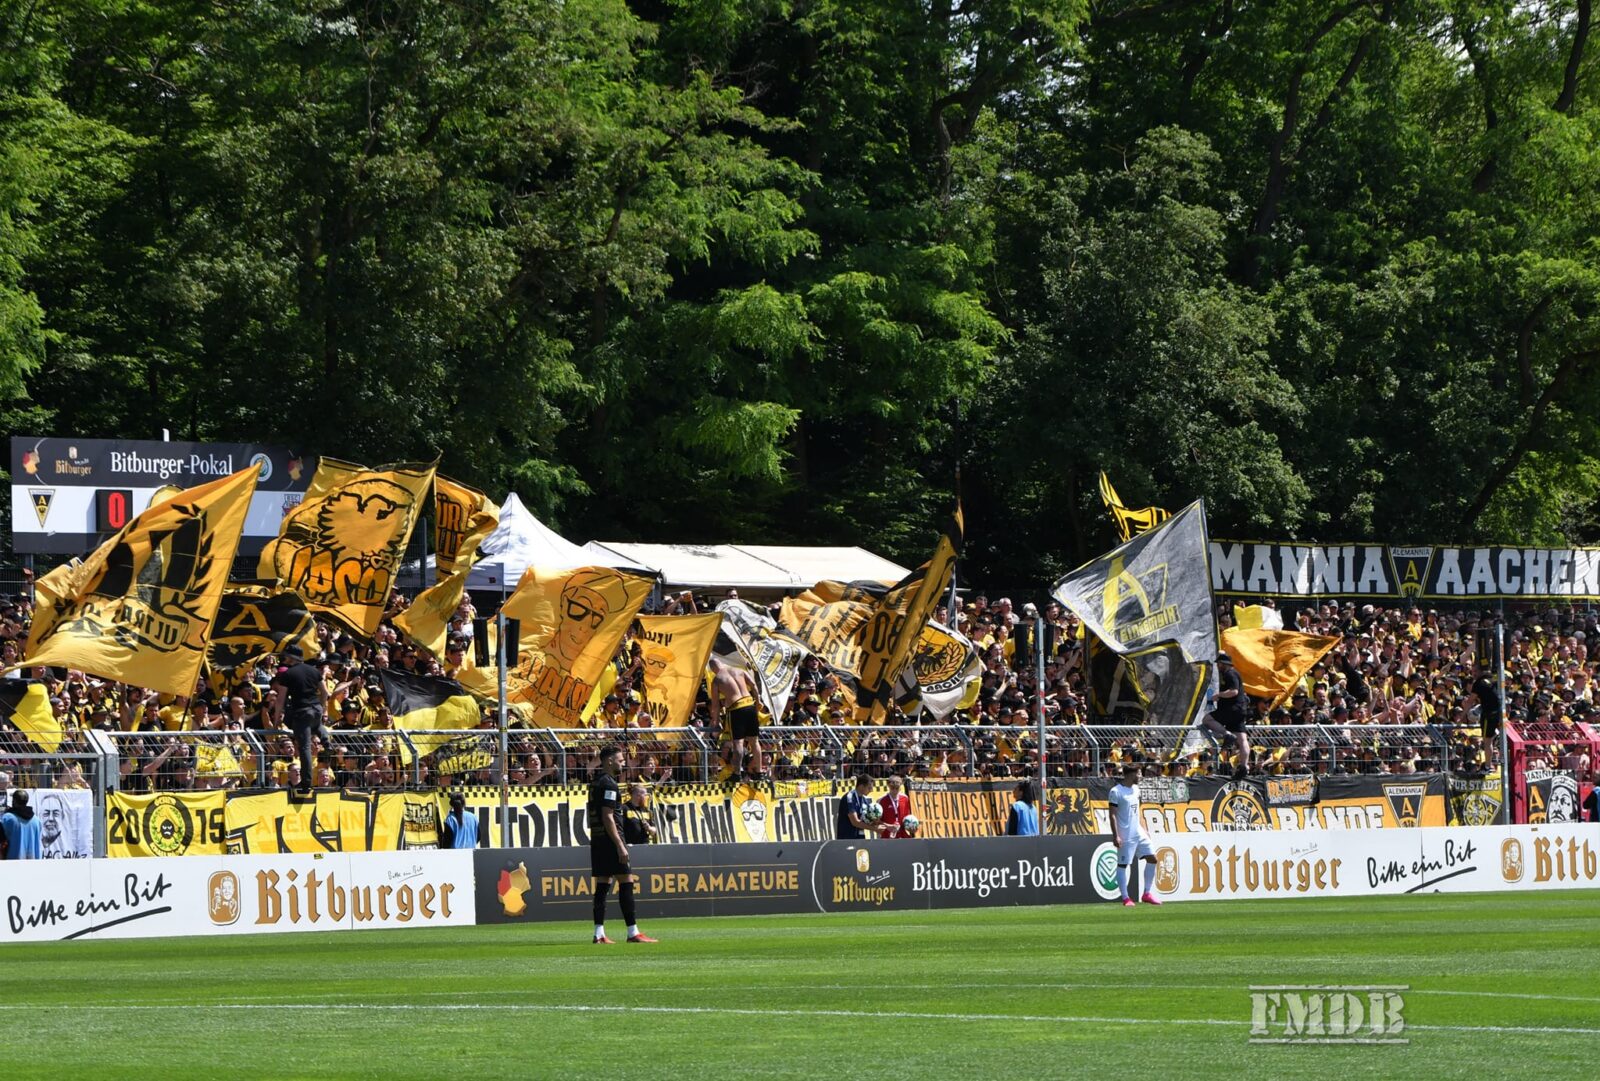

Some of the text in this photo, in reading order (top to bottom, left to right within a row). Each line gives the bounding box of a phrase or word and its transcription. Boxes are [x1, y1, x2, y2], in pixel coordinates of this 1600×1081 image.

[55, 460, 92, 476] Bitburger
[110, 451, 233, 479] Bitburger-Pokal
[108, 492, 125, 528] 0
[1436, 547, 1600, 595] AACHEN
[1388, 787, 1422, 795] ALEMANNIA
[912, 856, 1074, 898] Bitburger-Pokal
[1189, 844, 1342, 894] Bitburger
[1367, 839, 1477, 888] Bitte ein Bit
[254, 868, 455, 925] Bitburger
[541, 870, 799, 897] FINALAG DER AMATEURE
[832, 876, 895, 905] Bitburger
[7, 873, 172, 934] Bitte ein Bit
